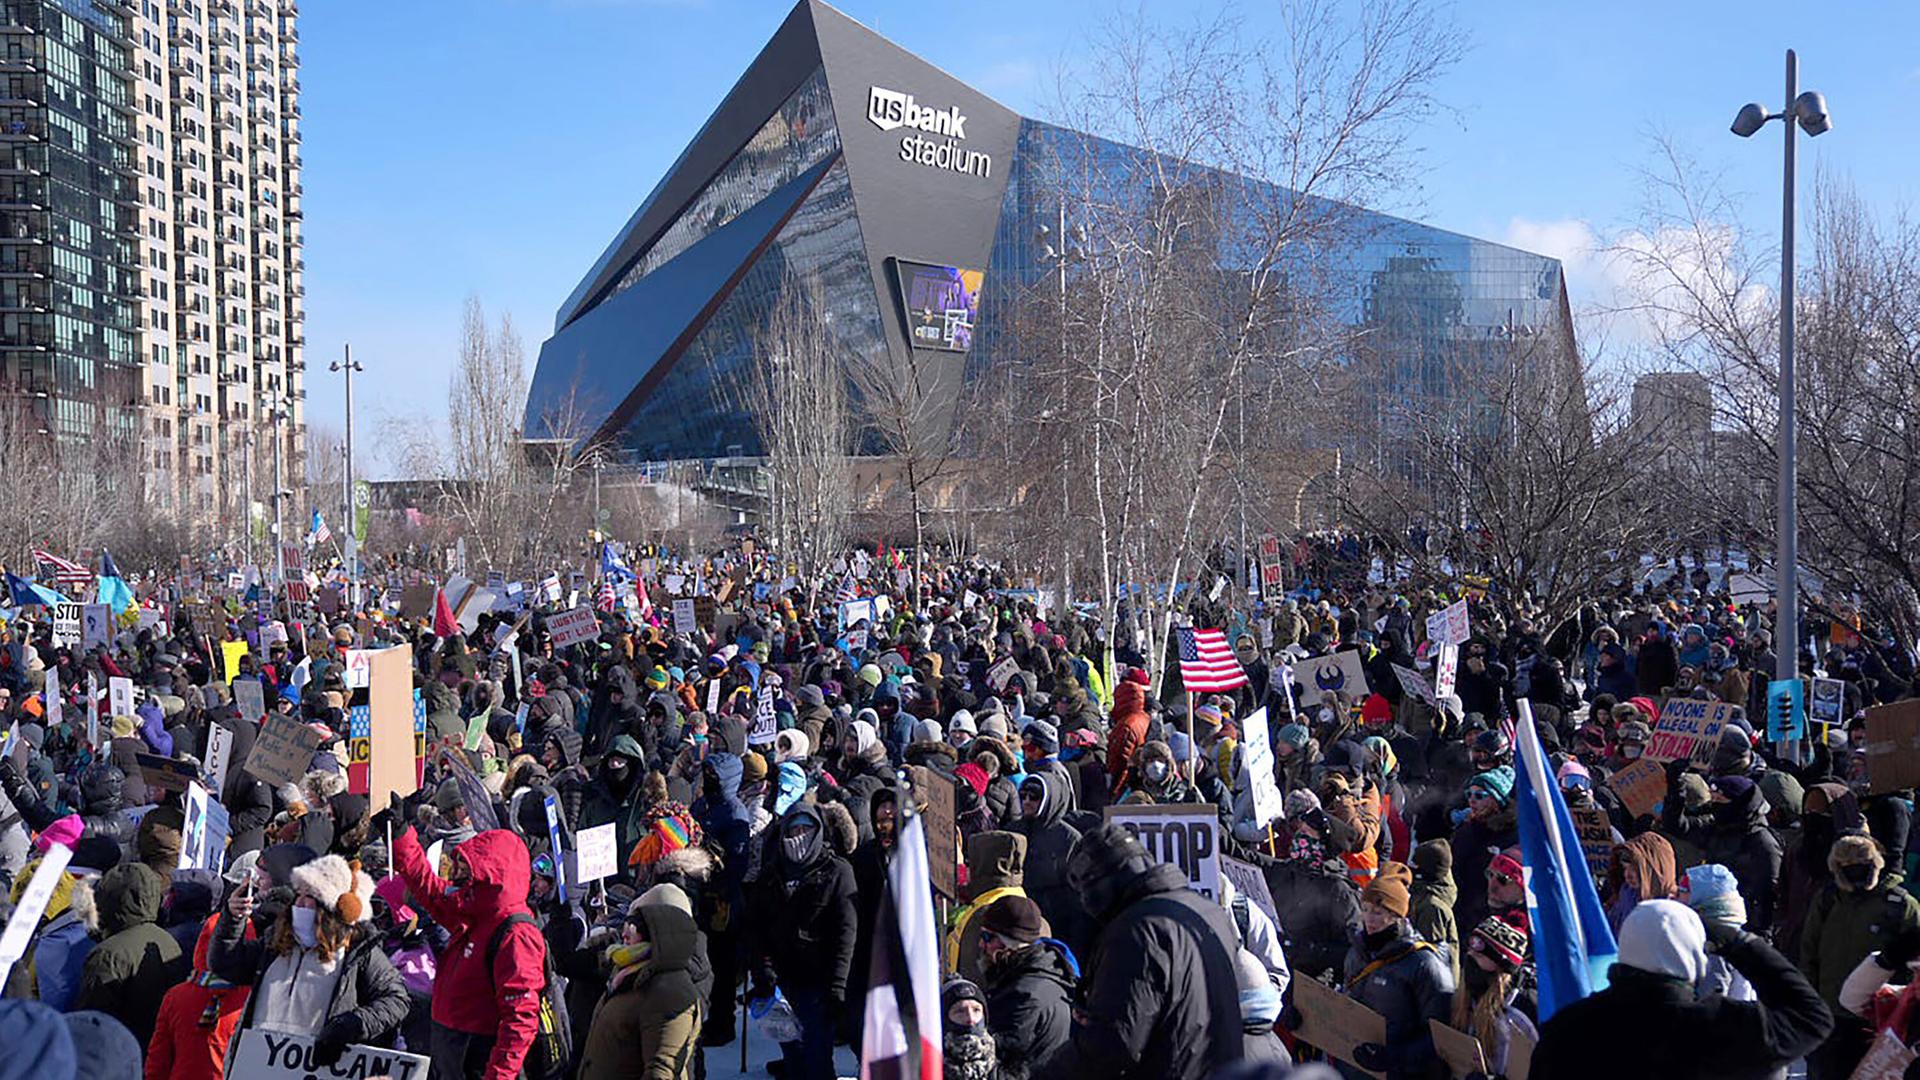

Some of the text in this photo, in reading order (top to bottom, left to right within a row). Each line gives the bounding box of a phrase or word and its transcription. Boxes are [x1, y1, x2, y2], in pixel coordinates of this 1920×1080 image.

[900, 134, 991, 178] stadium
[283, 547, 301, 567] NO
[1264, 565, 1280, 583] NO
[287, 581, 307, 602] NO
[1265, 582, 1282, 598] ICE
[56, 603, 80, 621] STO
[291, 602, 309, 619] ICE
[551, 611, 592, 629] JUSTICE
[553, 625, 598, 643] NOT LIES
[1713, 705, 1726, 721] IS
[1703, 723, 1721, 737] ON
[264, 1034, 320, 1073] YOU
